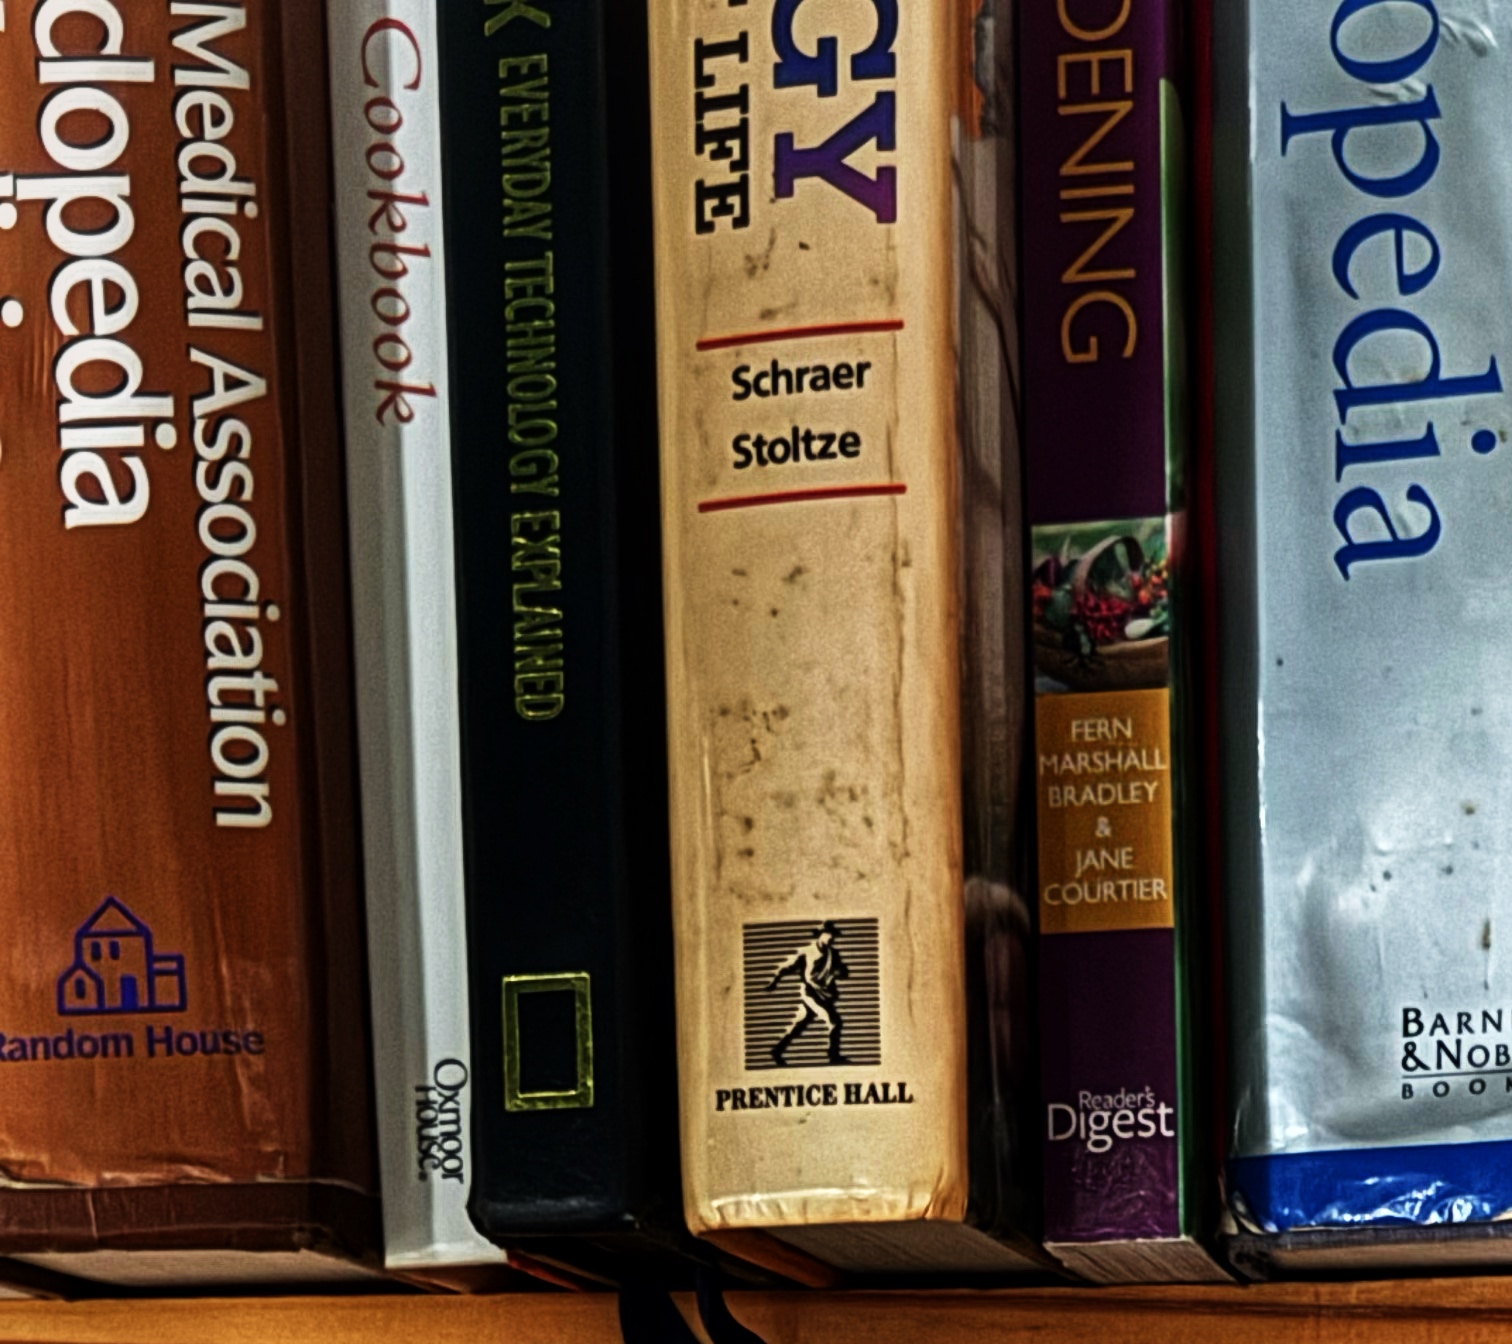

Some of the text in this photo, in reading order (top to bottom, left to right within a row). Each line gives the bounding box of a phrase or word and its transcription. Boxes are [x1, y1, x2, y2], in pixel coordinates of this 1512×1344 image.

[694, 31, 751, 236] LIFE
[771, 0, 899, 225] GY
[361, 17, 437, 427] Cookbook
[1280, 0, 1504, 583] opedia
[499, 52, 565, 721] EVERYDAY TECHNOLOGY EXPLAINED
[732, 359, 872, 401] Schraer
[169, 2, 284, 830] Medical Association
[732, 426, 863, 471] Stoltze
[1070, 717, 1133, 743] FERN
[1039, 746, 1168, 776] MARSHALL
[1047, 780, 1159, 808] BRADLEY
[1094, 816, 1112, 839] &
[1074, 847, 1135, 879] JANE
[1043, 877, 1168, 906] COURTIER
[146, 1025, 265, 1060] House
[715, 1081, 915, 1112] PRENTICE HALL
[1047, 1101, 1176, 1153] Digest
